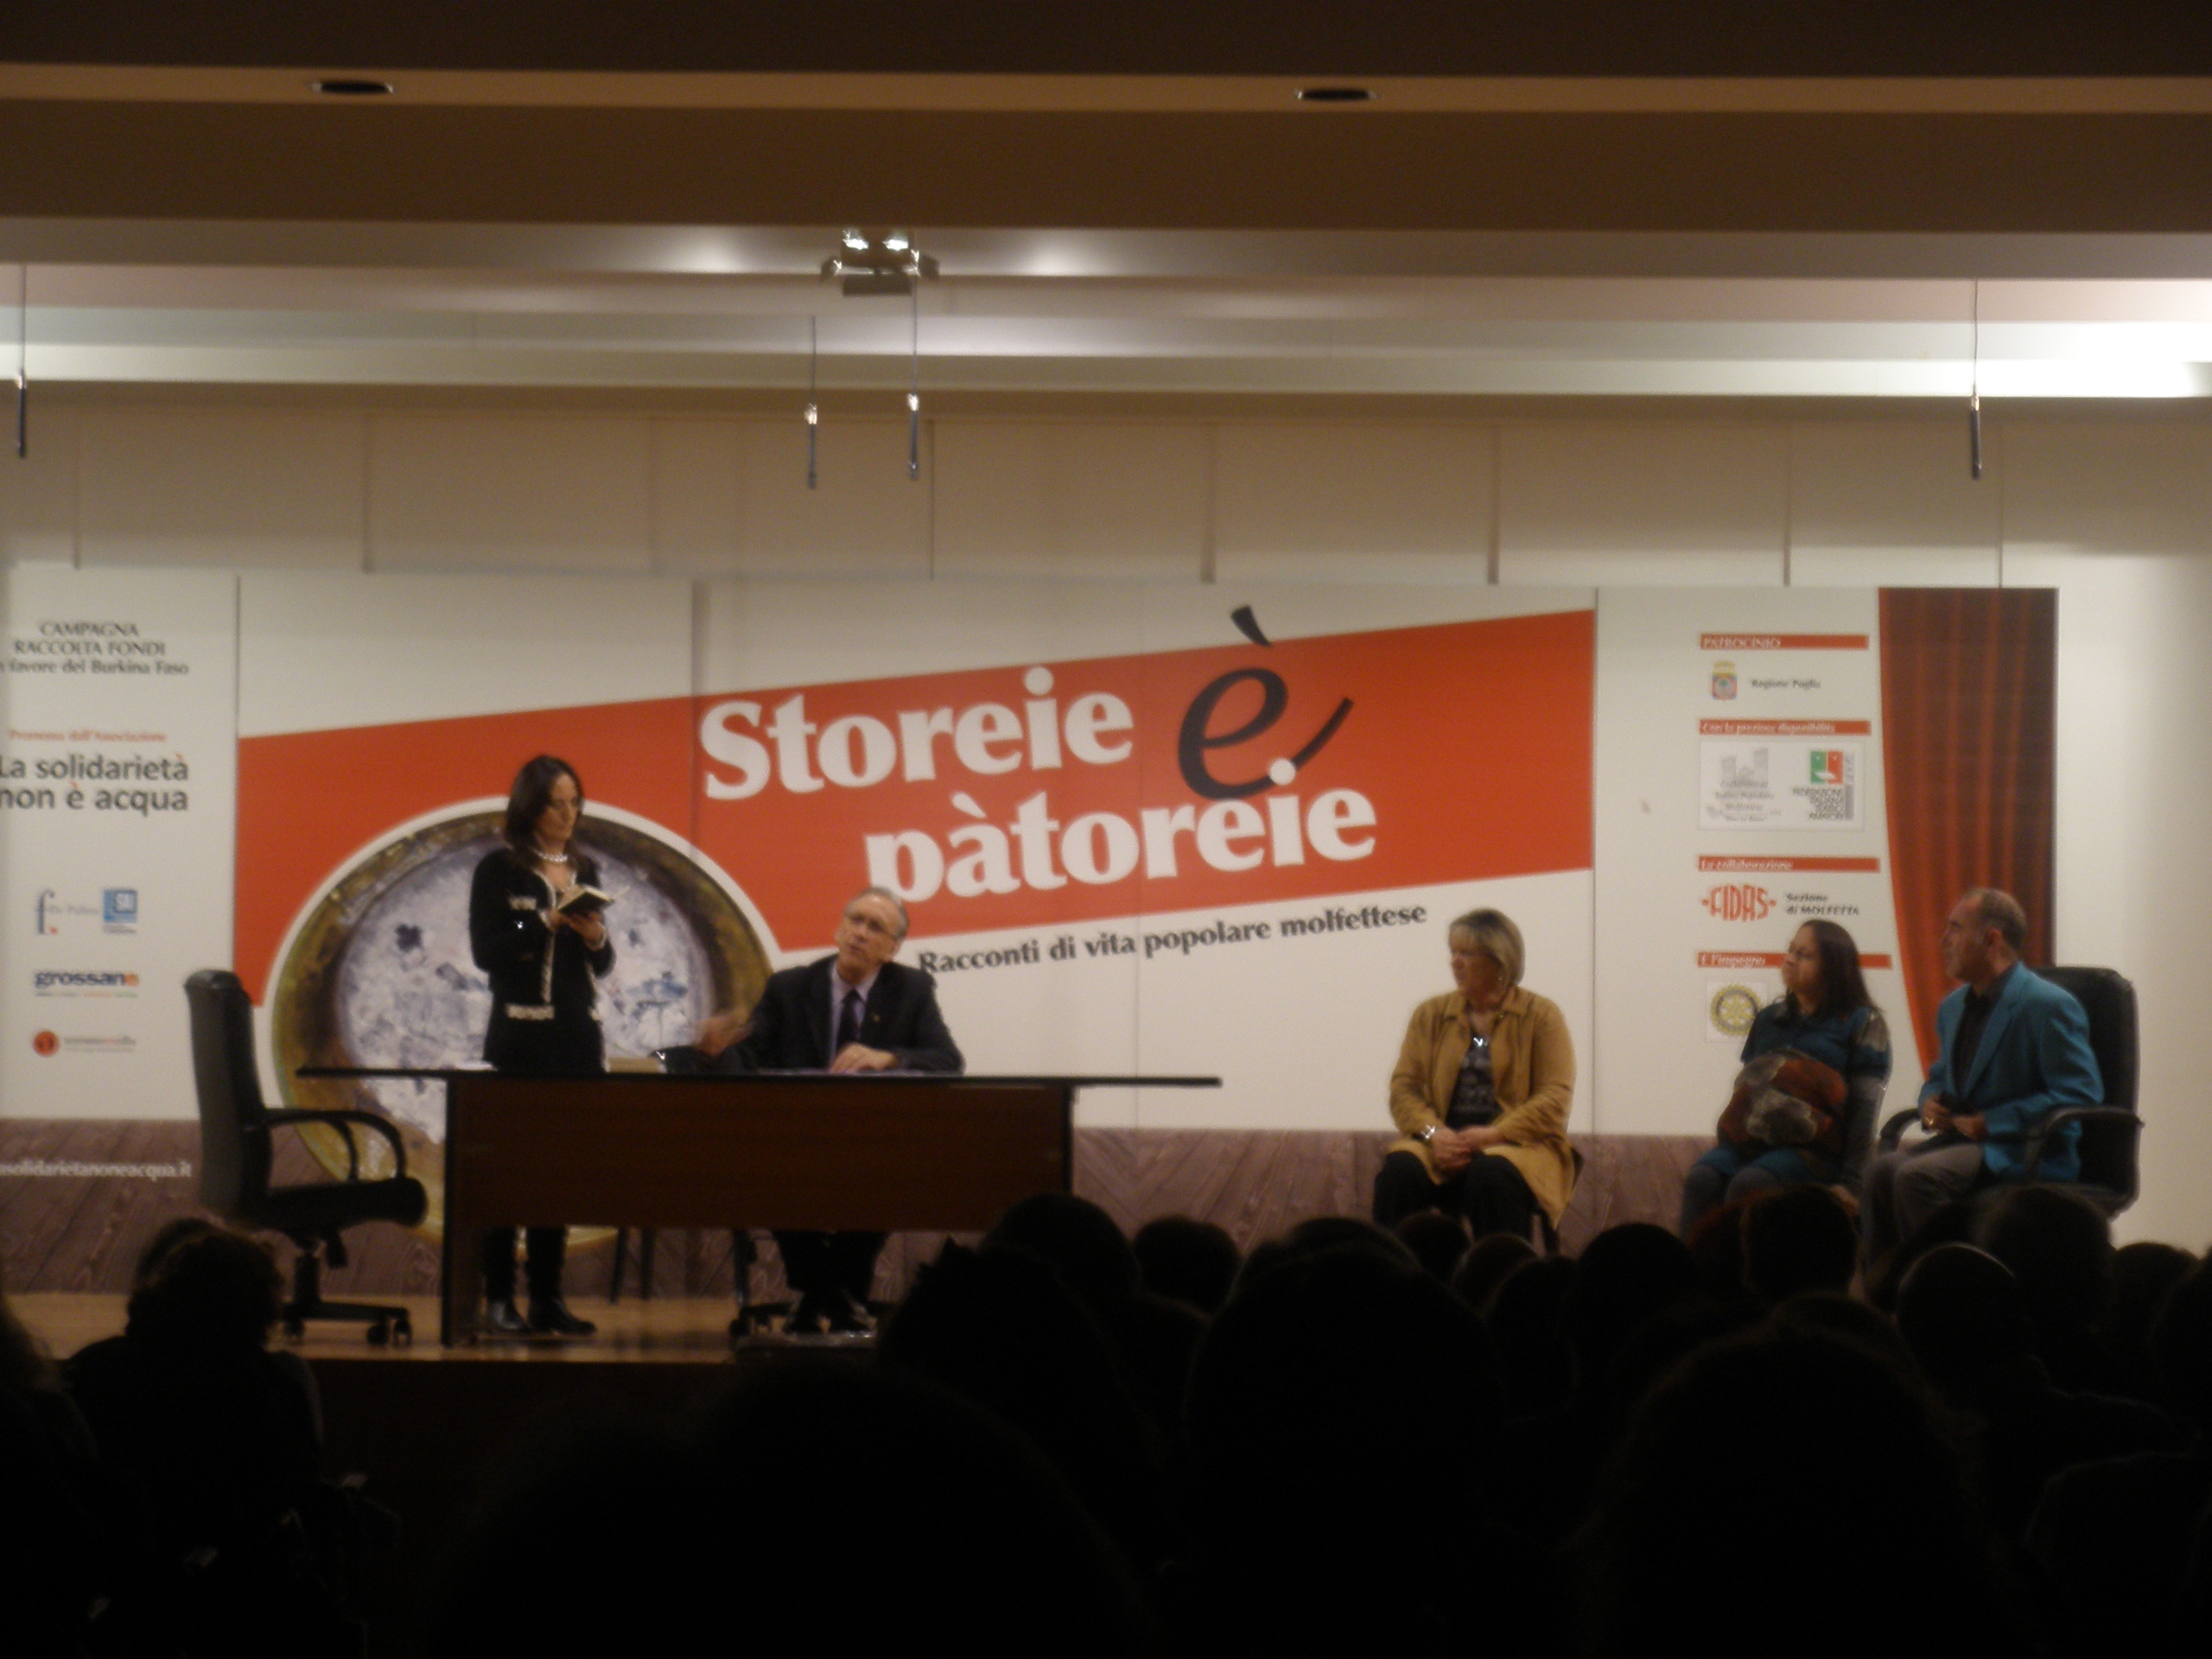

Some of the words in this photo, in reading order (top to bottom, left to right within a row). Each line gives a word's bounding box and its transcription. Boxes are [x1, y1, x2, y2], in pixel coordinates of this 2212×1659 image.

[41, 622, 138, 636] CAMPAGNA
[1703, 636, 1781, 649] PATROCINIO
[15, 640, 102, 654] RACCOLTA
[109, 642, 165, 655] FONDI
[156, 661, 188, 674] Faso
[700, 667, 1134, 800] Storeie
[1177, 605, 1354, 800] è
[36, 753, 188, 780] solidarietà
[0, 788, 55, 810] non
[67, 781, 84, 810] è
[95, 790, 188, 817] acqua
[865, 757, 1376, 903] pàtoreie
[1710, 884, 1770, 921] FIDAS
[918, 938, 1040, 973] Racconti
[1050, 936, 1077, 961] di
[1085, 931, 1135, 957] vita
[1144, 919, 1271, 958] popolare
[1281, 906, 1428, 937] molfettese
